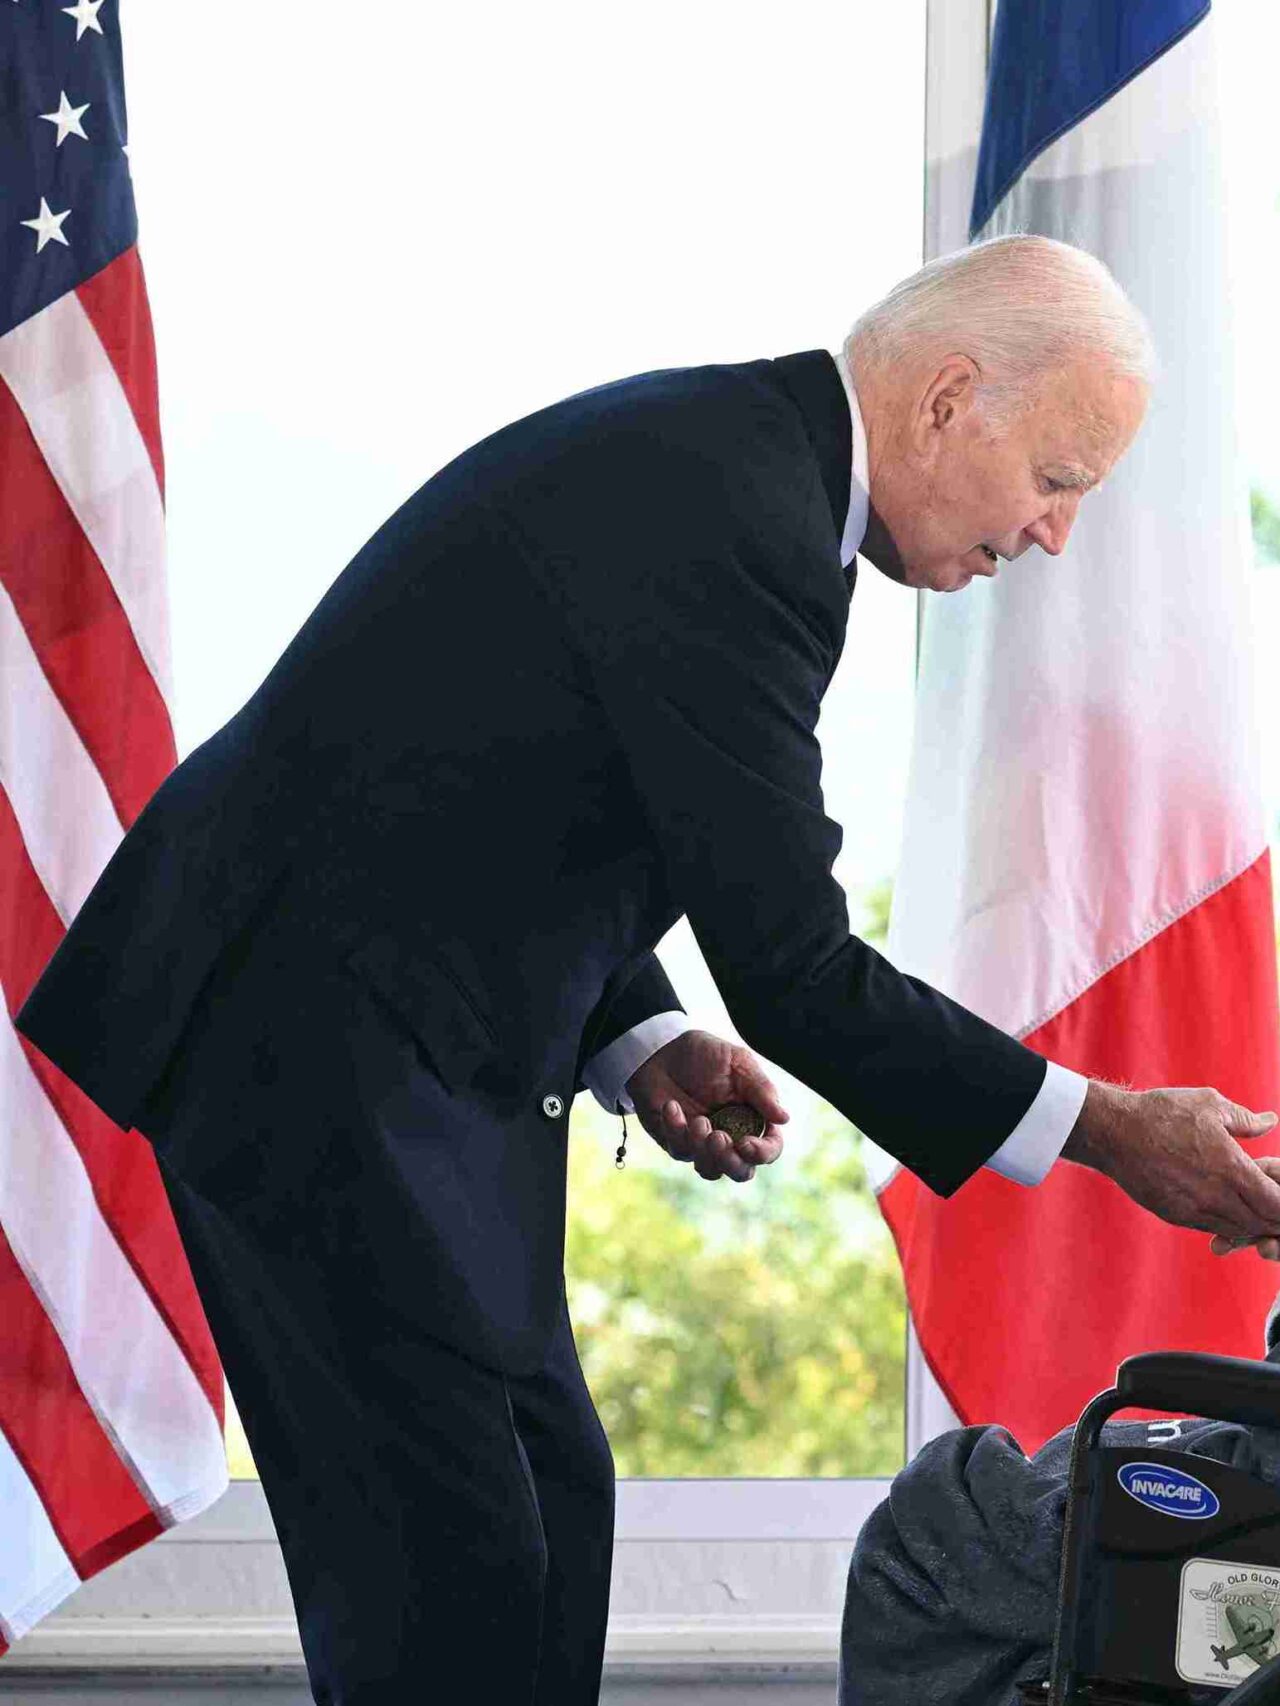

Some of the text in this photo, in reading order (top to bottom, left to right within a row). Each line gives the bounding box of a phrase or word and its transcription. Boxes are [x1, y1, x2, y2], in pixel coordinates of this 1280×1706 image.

[1131, 1479, 1202, 1502] INVACARE
[1227, 1573, 1248, 1585] OLD
[1189, 1581, 1256, 1606] Honor
